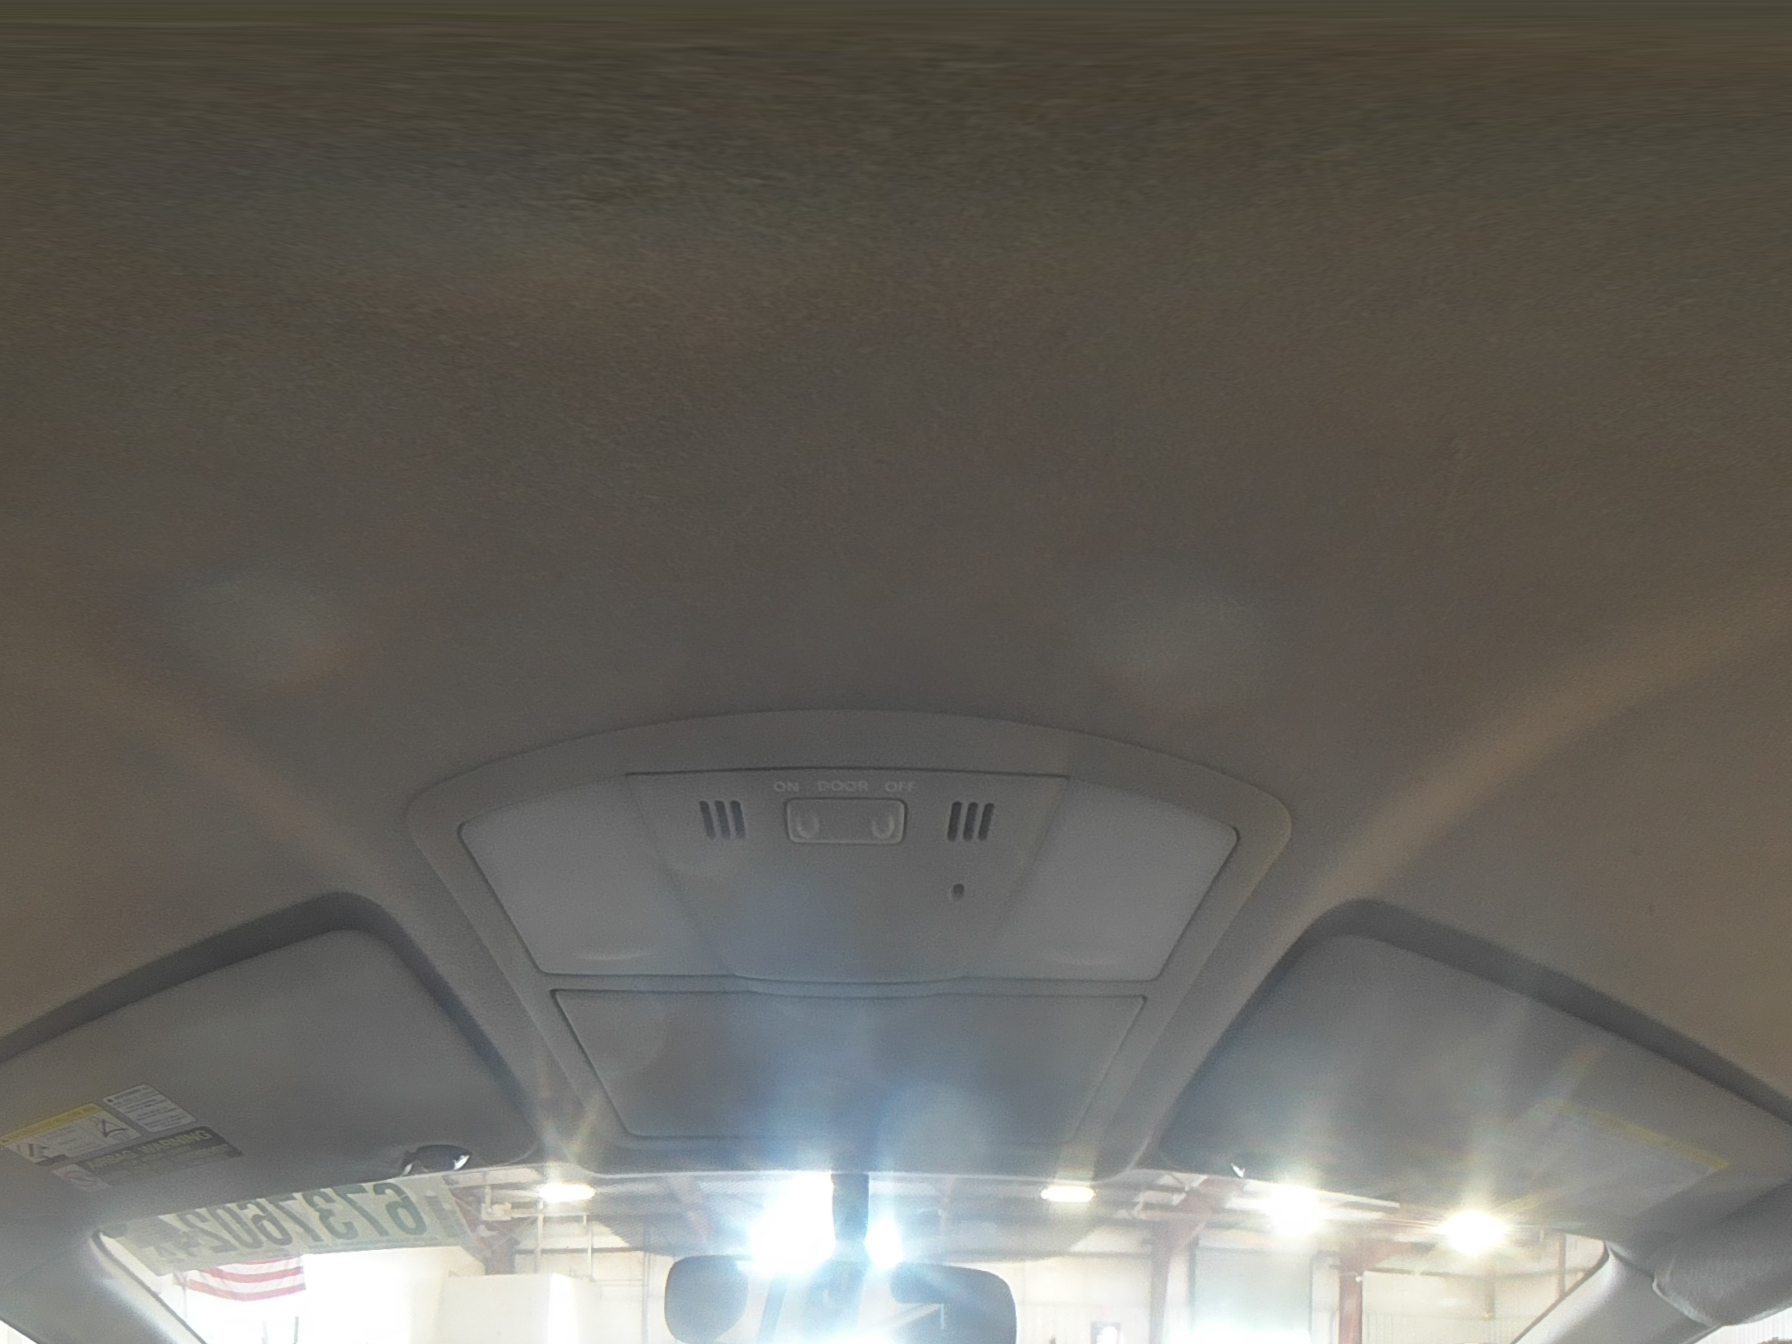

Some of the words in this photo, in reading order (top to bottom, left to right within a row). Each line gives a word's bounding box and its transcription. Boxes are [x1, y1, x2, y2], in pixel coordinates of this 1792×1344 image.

[773, 781, 800, 793] ON
[817, 780, 869, 792] DOOR
[885, 781, 918, 793] OFF
[138, 1128, 213, 1156] WARNING
